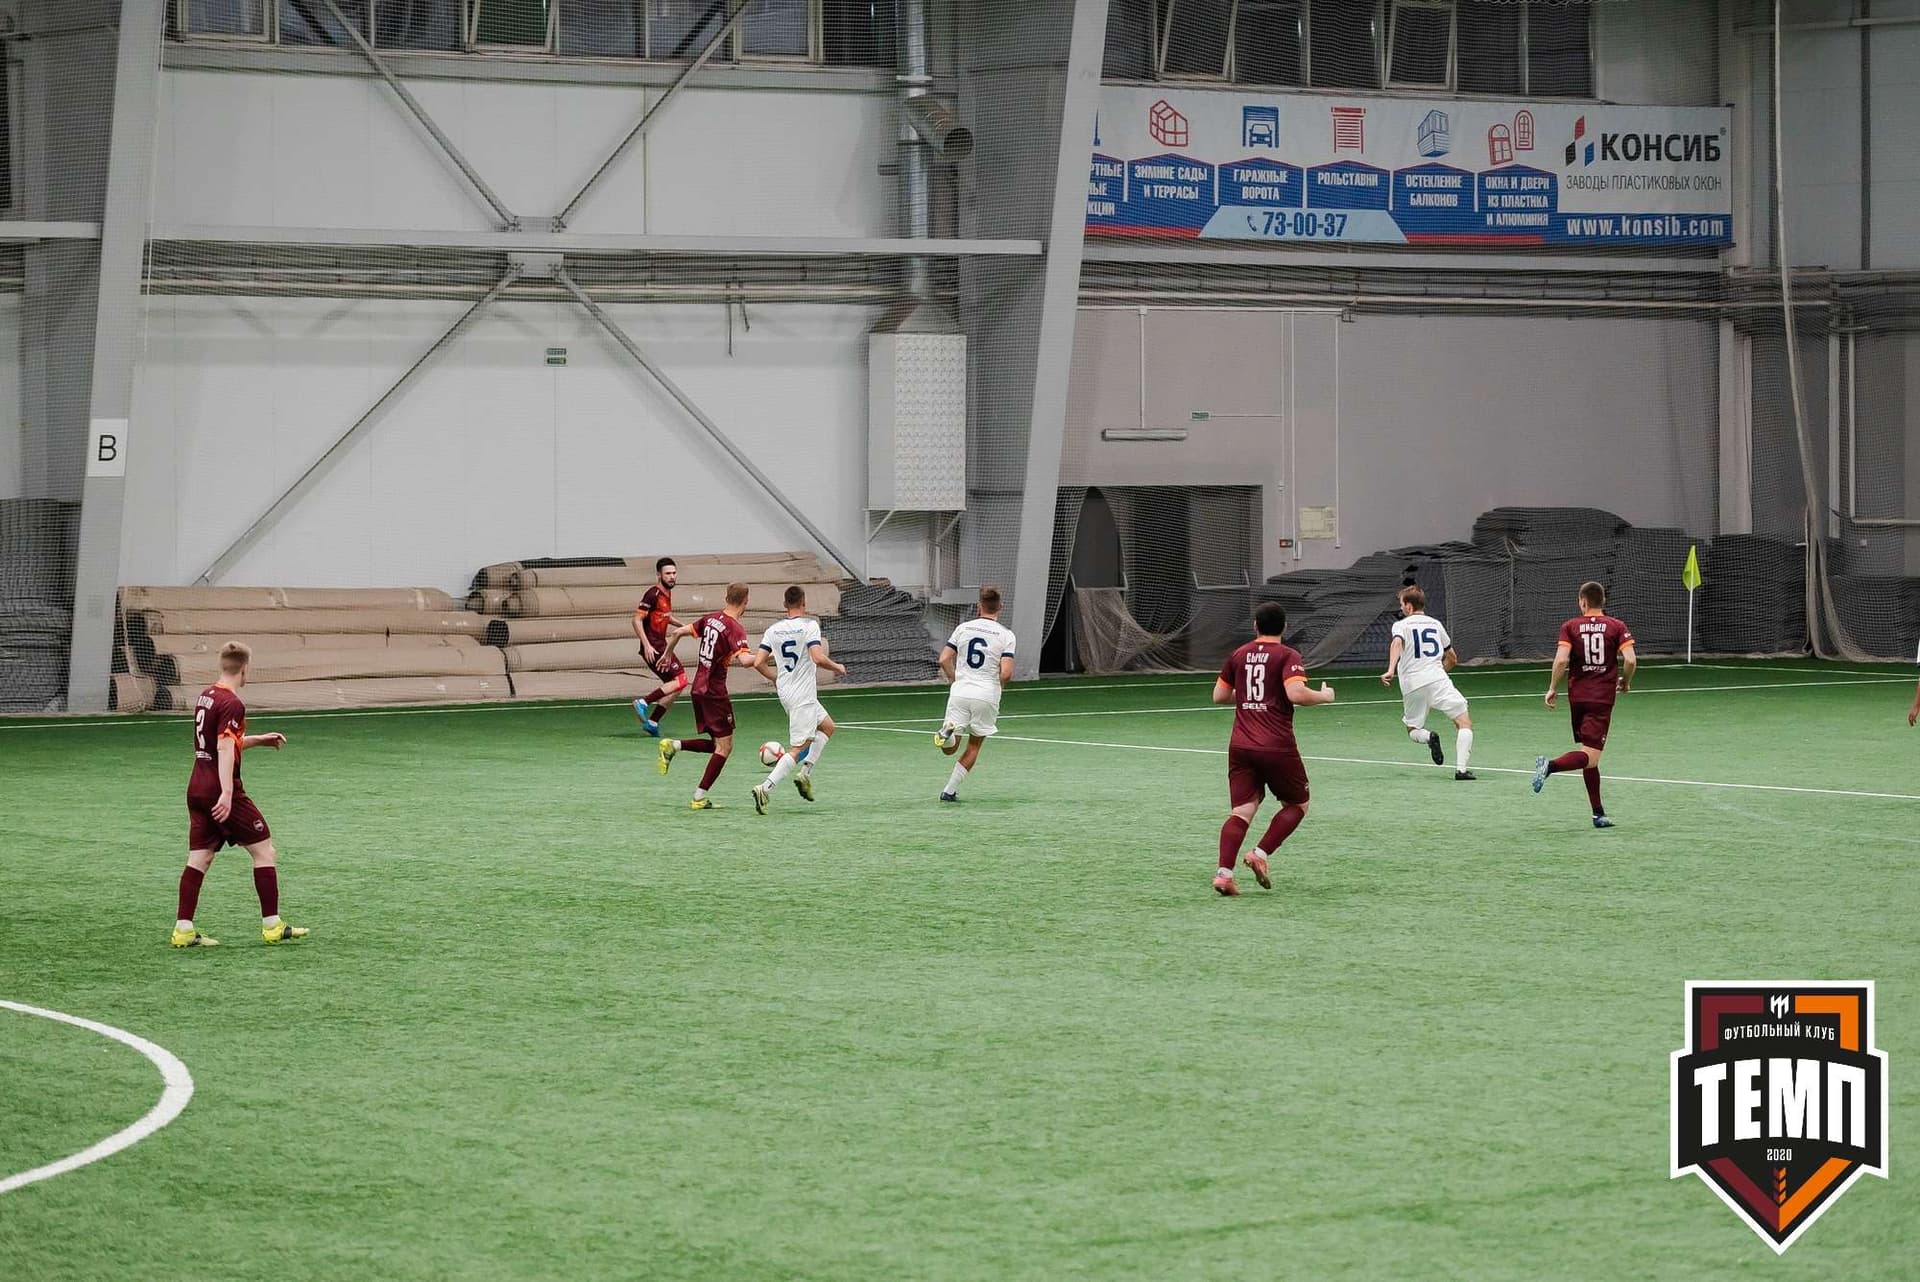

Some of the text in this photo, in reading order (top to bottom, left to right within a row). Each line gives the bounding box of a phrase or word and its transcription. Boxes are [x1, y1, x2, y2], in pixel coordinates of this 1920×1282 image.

[1601, 133, 1721, 162] КОНСИБ
[1135, 165, 1208, 181] ЗИМНИЕ САДЫ
[1233, 169, 1288, 184] ГАРАЖНЫЕ
[1318, 172, 1379, 187] РОЛЬСТАВНИ
[1406, 175, 1462, 188] ОСТЕКЛЕНИЕ
[1485, 176, 1550, 190] ОКНА И ДВЕРИ
[1566, 175, 1722, 192] ЗАВОДЫ ПЛАСТИКОВЫХ ОКОН
[1143, 185, 1199, 199] И ТЕРРАСЫ
[1242, 186, 1280, 200] ВОРОТА
[1410, 193, 1458, 207] БАЛКОНОВ
[1488, 195, 1549, 208] ИЗ ПЛАСТИКА
[1262, 211, 1348, 237] 73-00-37
[1486, 213, 1549, 226] И АЛЮМИНИЯ
[1567, 216, 1724, 237] www.konsib.com
[700, 625, 719, 661] 33
[1412, 628, 1440, 659] 15
[1581, 633, 1605, 665] 19
[781, 640, 799, 672] 5
[967, 637, 988, 669] 6
[1245, 664, 1266, 701] 13
[196, 709, 206, 749] 2
